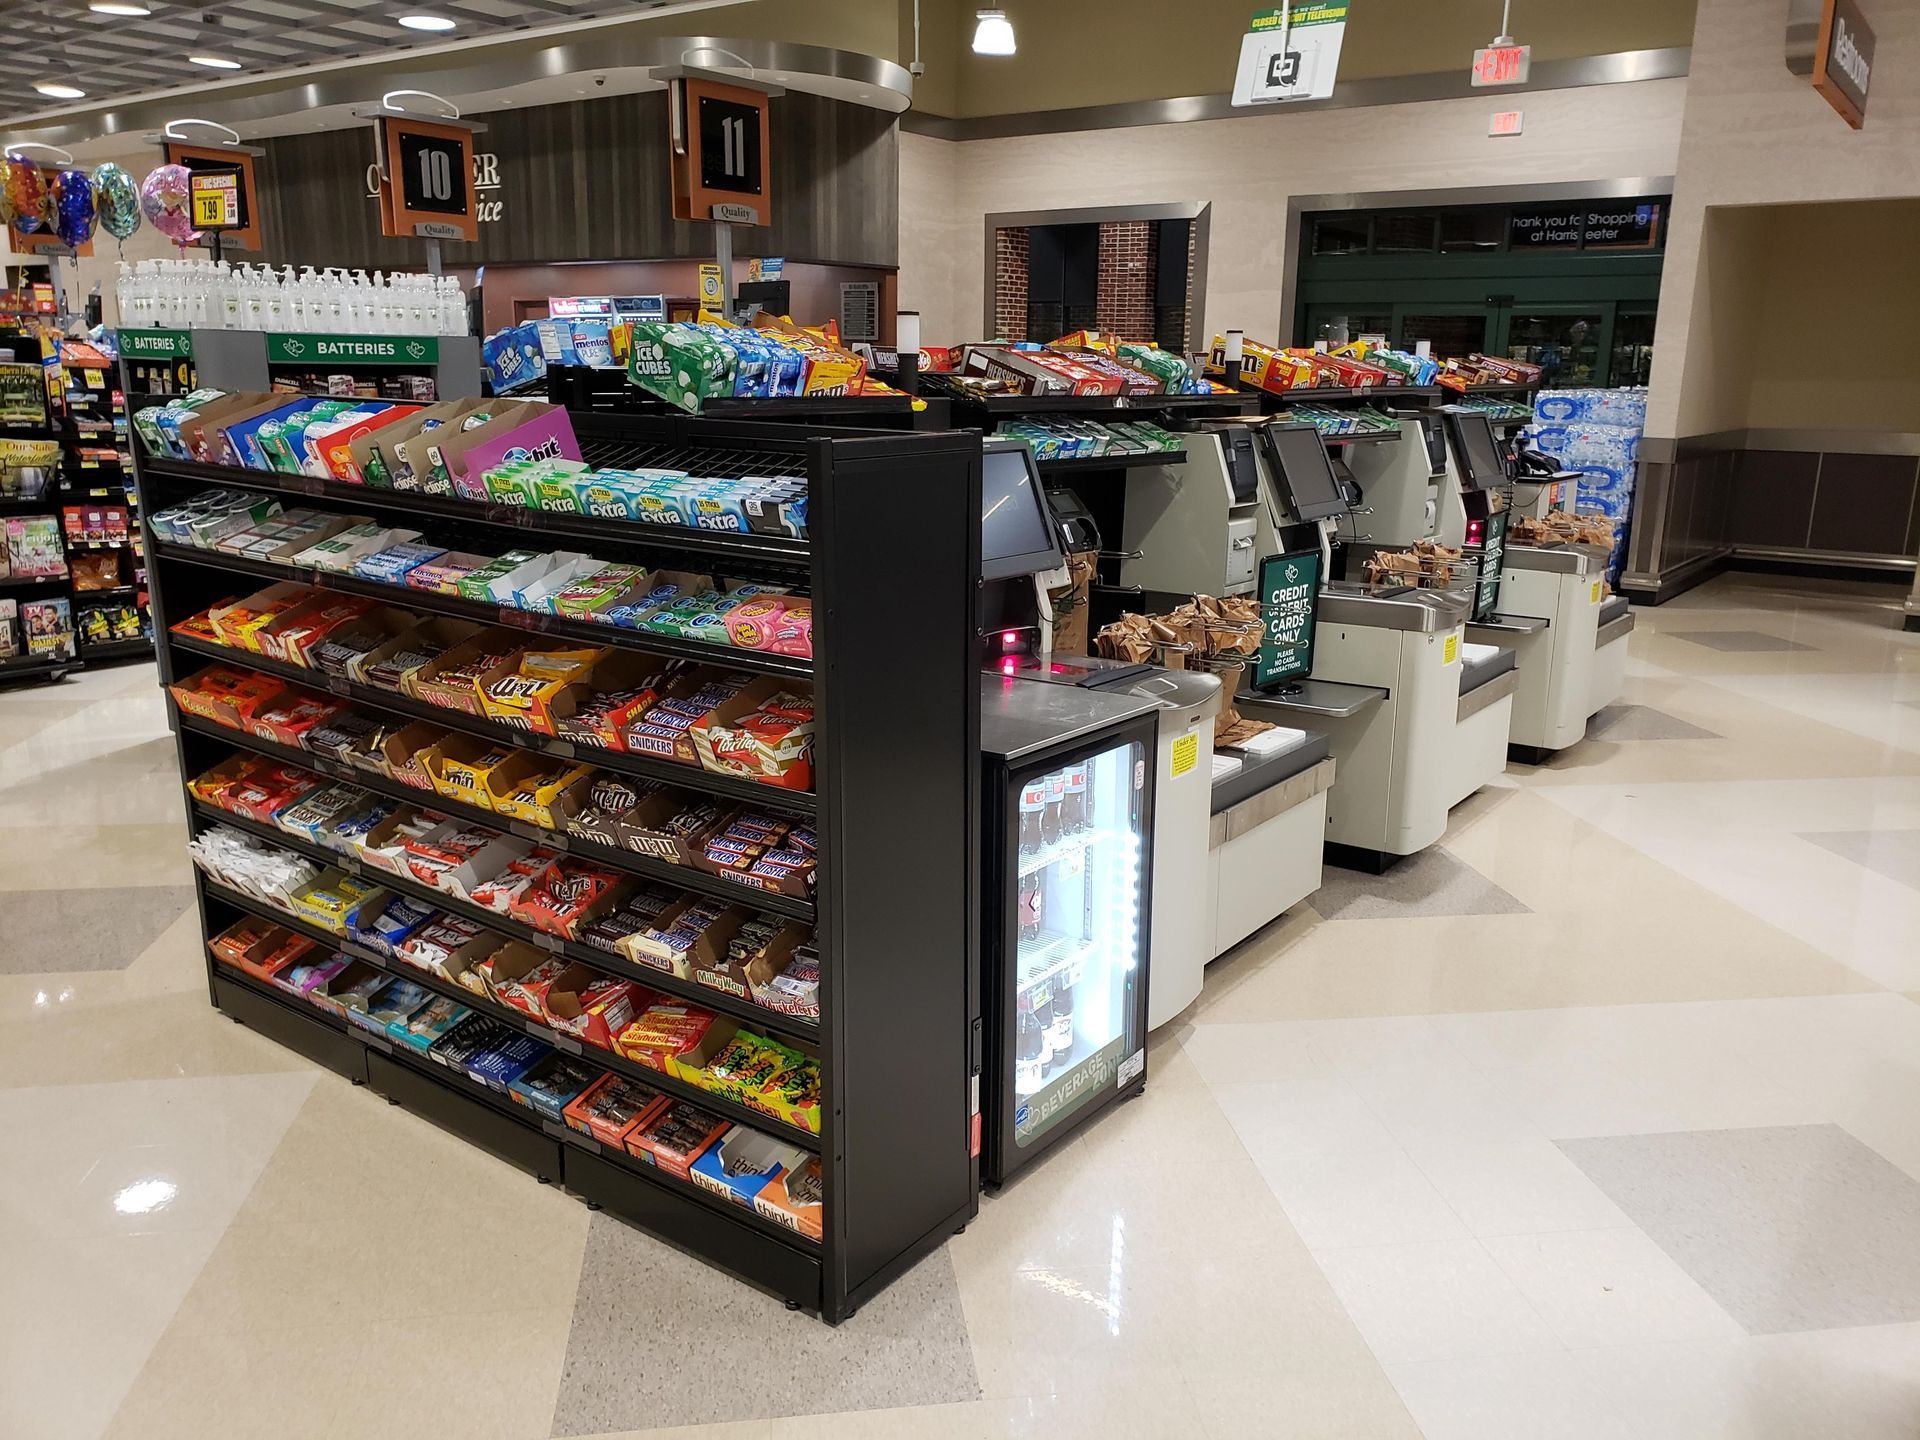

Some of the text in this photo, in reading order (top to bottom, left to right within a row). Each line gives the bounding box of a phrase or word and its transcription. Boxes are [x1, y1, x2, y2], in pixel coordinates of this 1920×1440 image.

[1252, 16, 1278, 28] CLOSED
[1307, 7, 1347, 20] TELEVISION
[1481, 48, 1522, 82] EXIT
[1494, 112, 1518, 132] EXIT
[721, 117, 745, 178] 11
[418, 148, 452, 201] 10
[203, 200, 218, 220] 7.99
[720, 204, 752, 220] Quality
[1513, 212, 1648, 228] hank you fo Shopping
[424, 223, 456, 236] Quality
[1531, 228, 1620, 241] at Harris eeter
[134, 337, 175, 350] BATTERIES
[317, 342, 395, 355] BATTERIES
[575, 339, 609, 349] mentos
[498, 354, 511, 370] ICE
[582, 350, 600, 358] PURE
[636, 347, 652, 361] ICE
[502, 353, 522, 379] CUBES
[635, 360, 672, 375] CUBES
[770, 362, 779, 394] mentos
[987, 363, 1026, 392] HERSHEY'S
[393, 474, 419, 490] eclipse
[423, 478, 451, 495] eclipse
[456, 479, 489, 501] Orbit
[500, 477, 511, 487] STICKS
[547, 485, 560, 493] STICKS
[598, 488, 611, 497] STICKS
[648, 497, 661, 506] STICKS
[705, 501, 720, 509] STICKS
[748, 500, 758, 509] 35
[1272, 584, 1309, 604] CREDIT
[26, 606, 41, 615] TV
[1280, 598, 1309, 618] DEBIT
[1271, 613, 1305, 633] CARDS
[1273, 628, 1301, 646] ONLY
[1274, 655, 1296, 667] NO CASH
[1277, 648, 1295, 659] PLEASE
[1266, 660, 1301, 676] TRANSACTIONS
[625, 696, 653, 720] SHARE
[630, 736, 673, 754] SNICKERS
[722, 870, 762, 888] SNICKERS
[638, 950, 669, 968] SNICKERS
[645, 1015, 687, 1026] Starburst
[635, 1023, 676, 1035] Starburst
[626, 1033, 668, 1043] Starburst
[1041, 1052, 1105, 1121] BEVERAGE
[709, 1085, 782, 1120] SOUR PATCH
[693, 1172, 728, 1200] think!
[757, 1202, 795, 1230] think!
